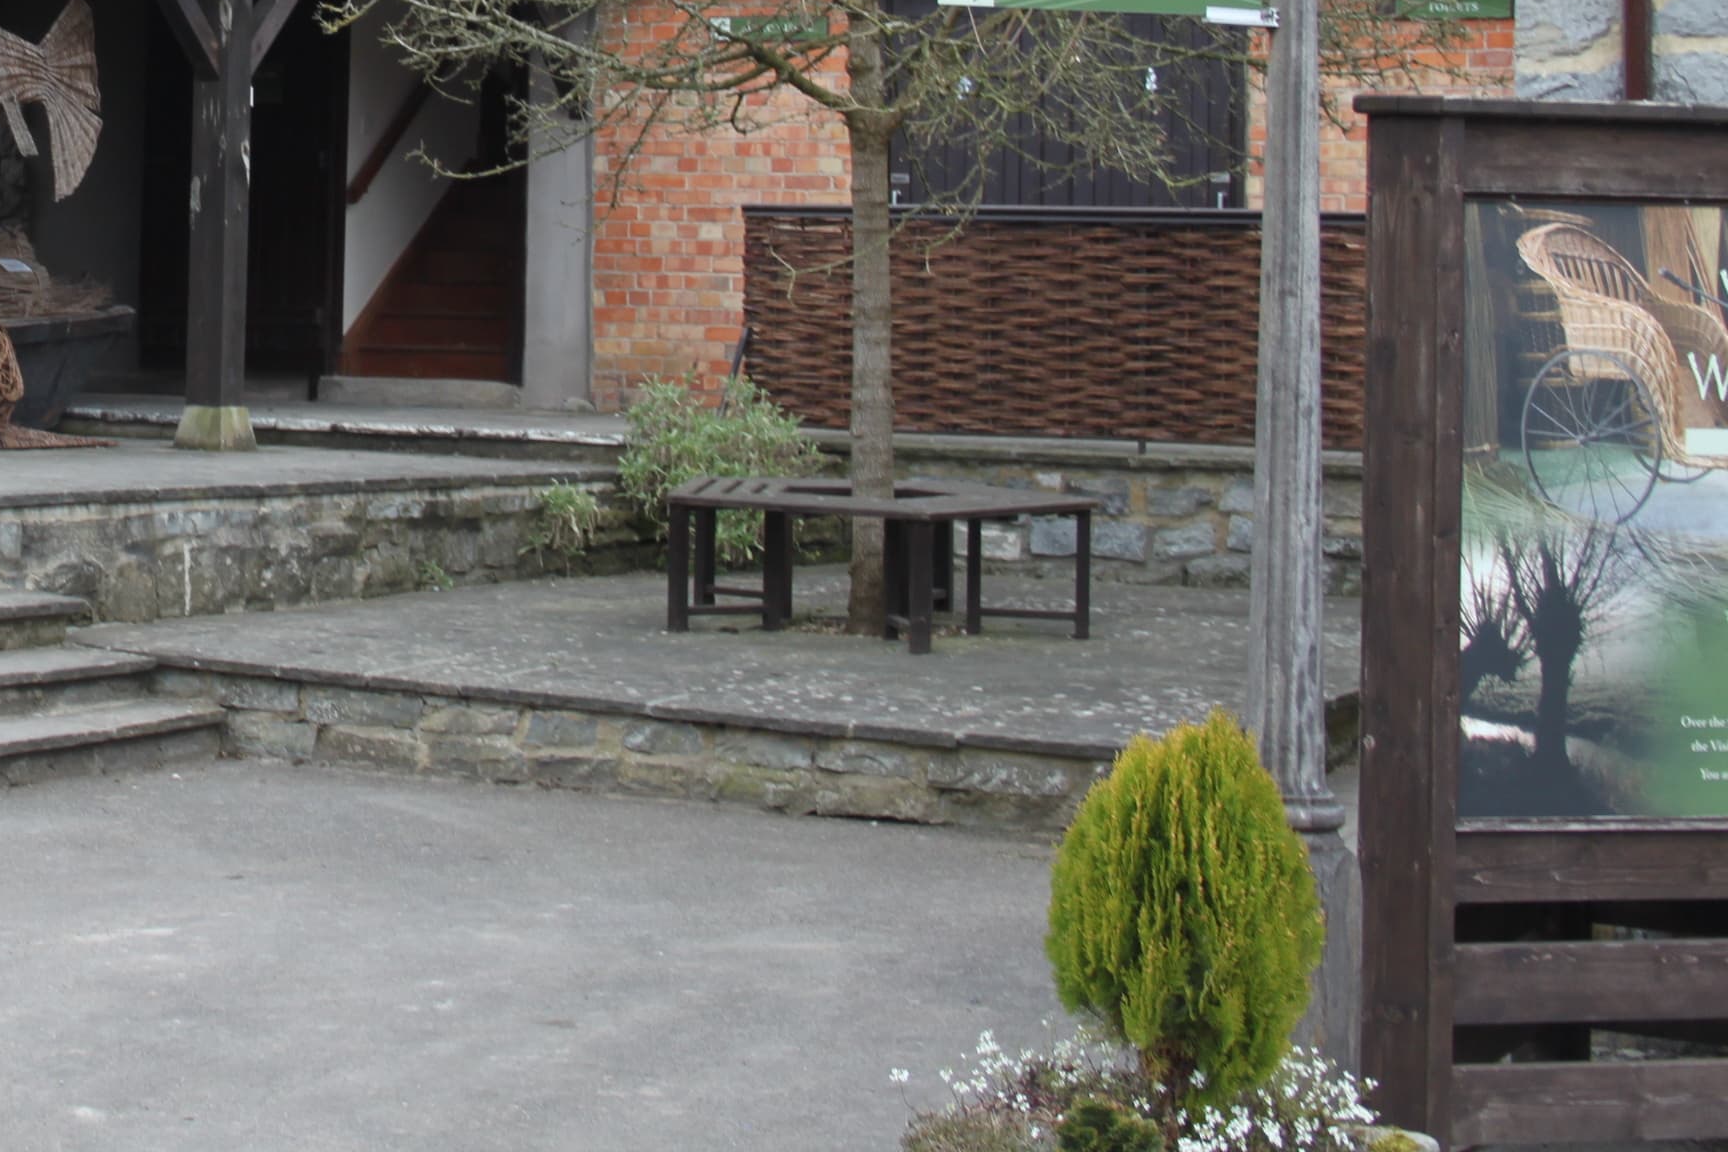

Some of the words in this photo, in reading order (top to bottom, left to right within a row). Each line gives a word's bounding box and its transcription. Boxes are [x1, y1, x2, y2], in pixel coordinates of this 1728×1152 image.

[1680, 715, 1707, 728] Over
[1690, 739, 1708, 752] the
[1699, 767, 1720, 780] You
